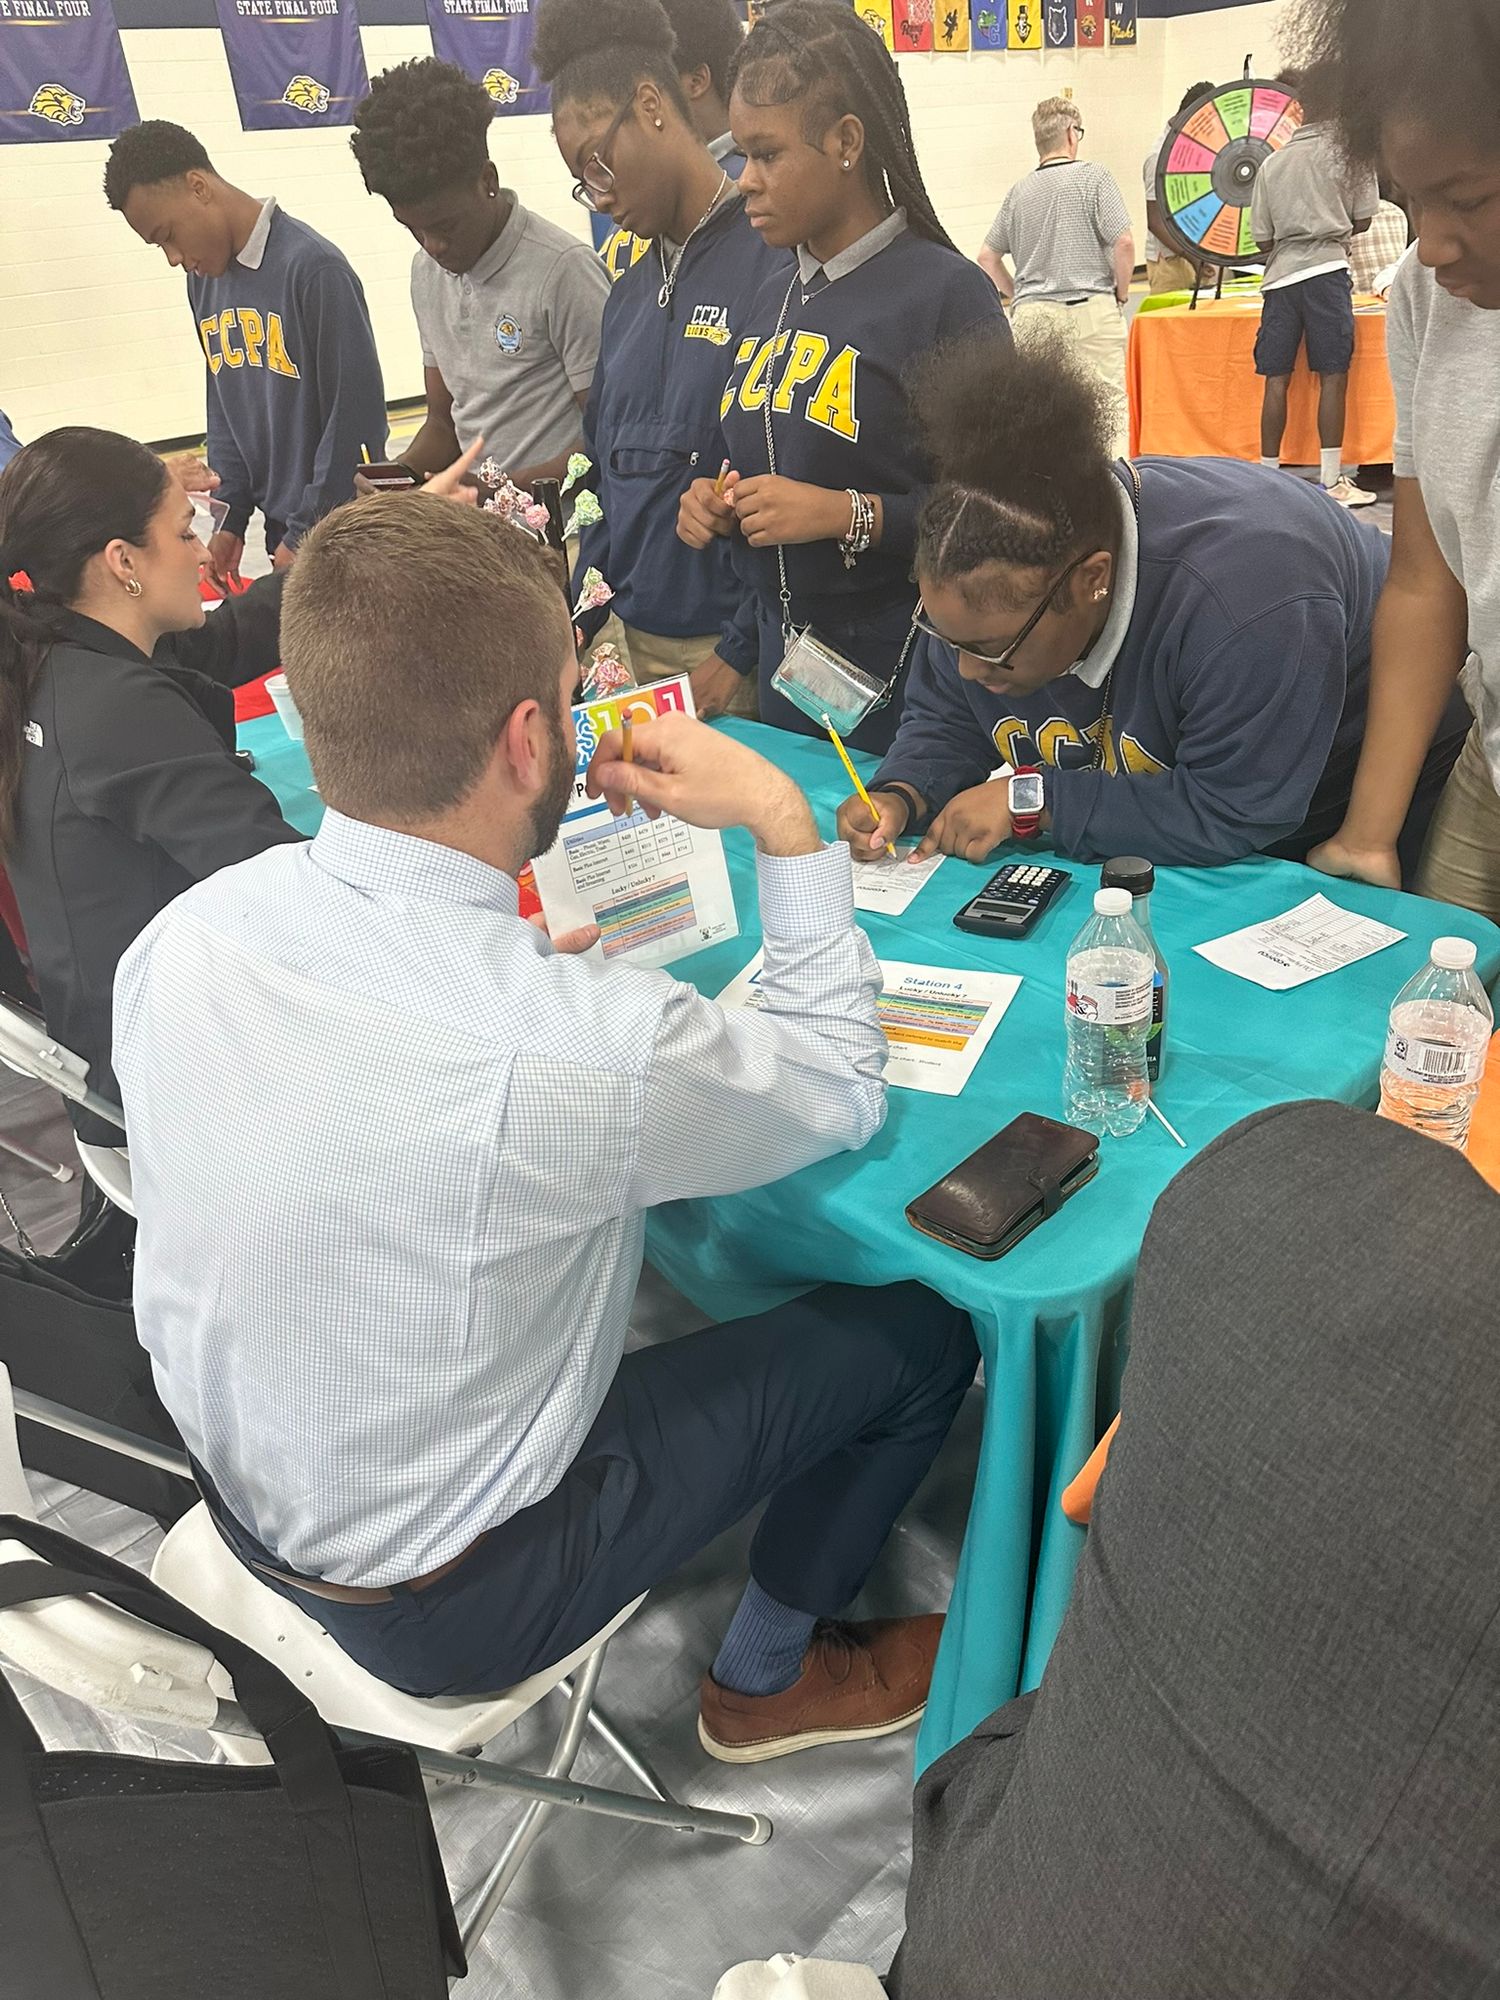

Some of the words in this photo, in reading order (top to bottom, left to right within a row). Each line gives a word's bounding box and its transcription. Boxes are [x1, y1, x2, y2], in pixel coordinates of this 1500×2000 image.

[13, 0, 55, 17] FINAL
[55, 0, 92, 17] FOUR
[236, 0, 273, 16] STATE
[274, 0, 308, 16] FINAL
[309, 0, 339, 15] FOUR
[443, 0, 474, 14] STATE
[474, 0, 504, 14] FINAL
[504, 0, 529, 13] FOUR
[1114, 2, 1124, 15] W
[690, 304, 728, 327] CCPA
[200, 307, 301, 380] CCPA
[611, 884, 628, 895] Lucky
[630, 875, 653, 889] Unlucky
[903, 976, 950, 990] Station
[899, 985, 922, 994] Lucky
[929, 989, 961, 998] Unlucky
